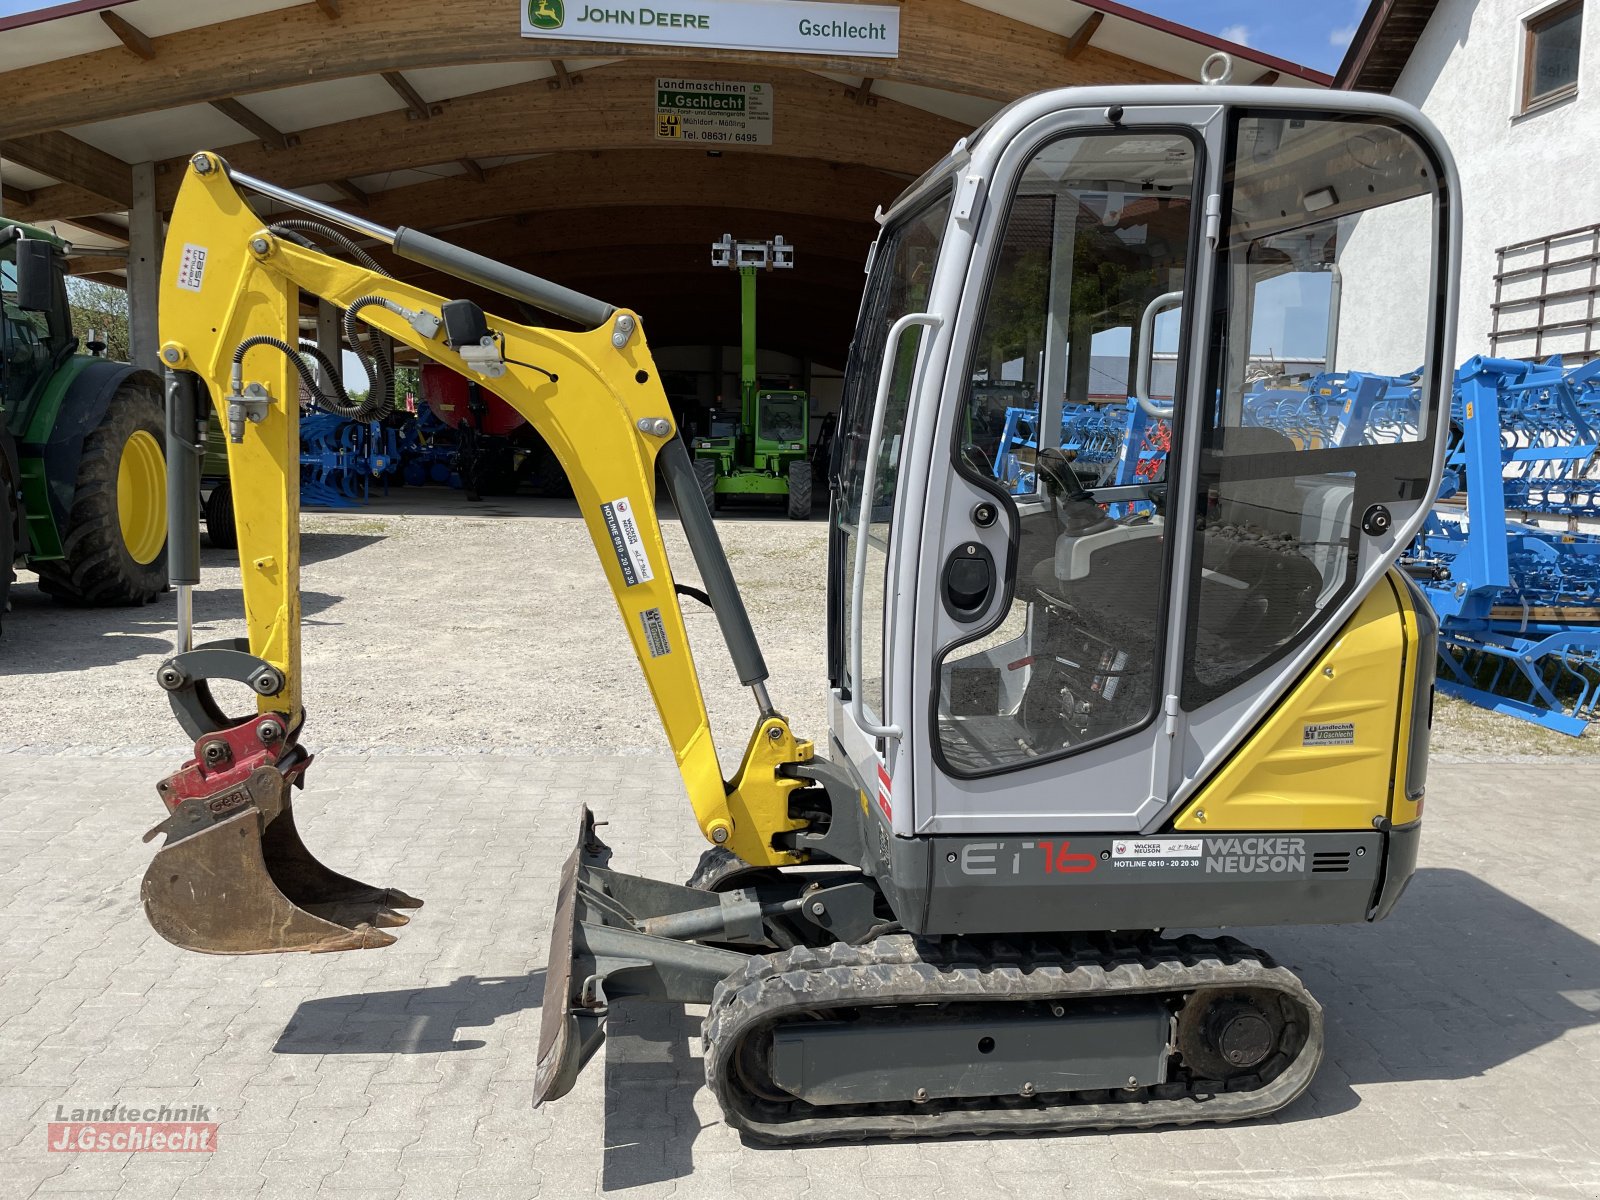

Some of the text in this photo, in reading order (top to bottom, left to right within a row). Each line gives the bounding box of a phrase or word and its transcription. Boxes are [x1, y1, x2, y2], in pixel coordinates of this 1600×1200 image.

[577, 5, 886, 40] JOHN DEERE Gschlecht
[657, 79, 746, 92] Landmaschinen
[660, 94, 743, 109] J. Gschlecht
[682, 130, 699, 140] Tel.
[735, 133, 757, 142] 6495
[187, 250, 199, 287] premium
[193, 251, 205, 288] used
[603, 505, 619, 537] HOTLINE
[627, 517, 638, 543] WACKER
[620, 557, 628, 566] 20
[624, 566, 632, 575] 20
[627, 575, 635, 584] 30
[1205, 838, 1306, 854] WACKER
[1205, 855, 1305, 873] NEUSON
